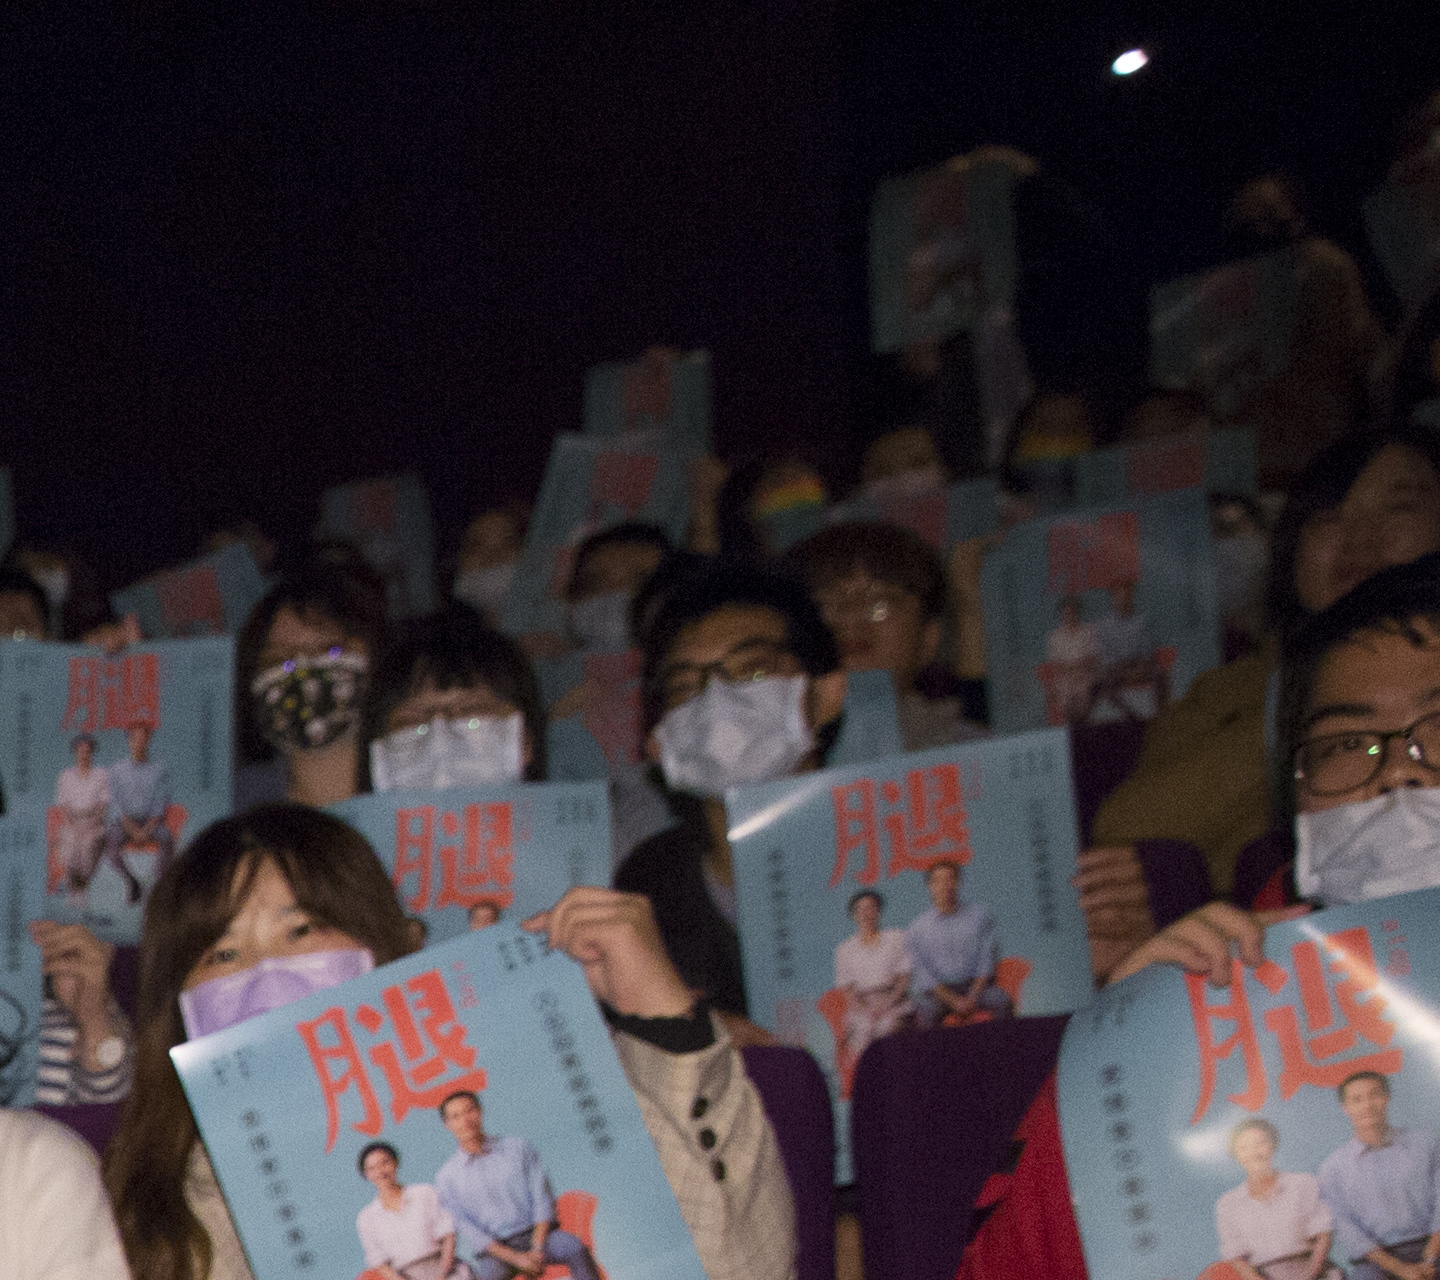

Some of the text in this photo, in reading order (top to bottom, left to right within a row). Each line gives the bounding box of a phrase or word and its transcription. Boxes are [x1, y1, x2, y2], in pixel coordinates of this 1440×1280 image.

[392, 802, 515, 913] 腿
[828, 762, 974, 889] 腿
[296, 968, 488, 1155] 腿
[1184, 925, 1403, 1125] 腿
